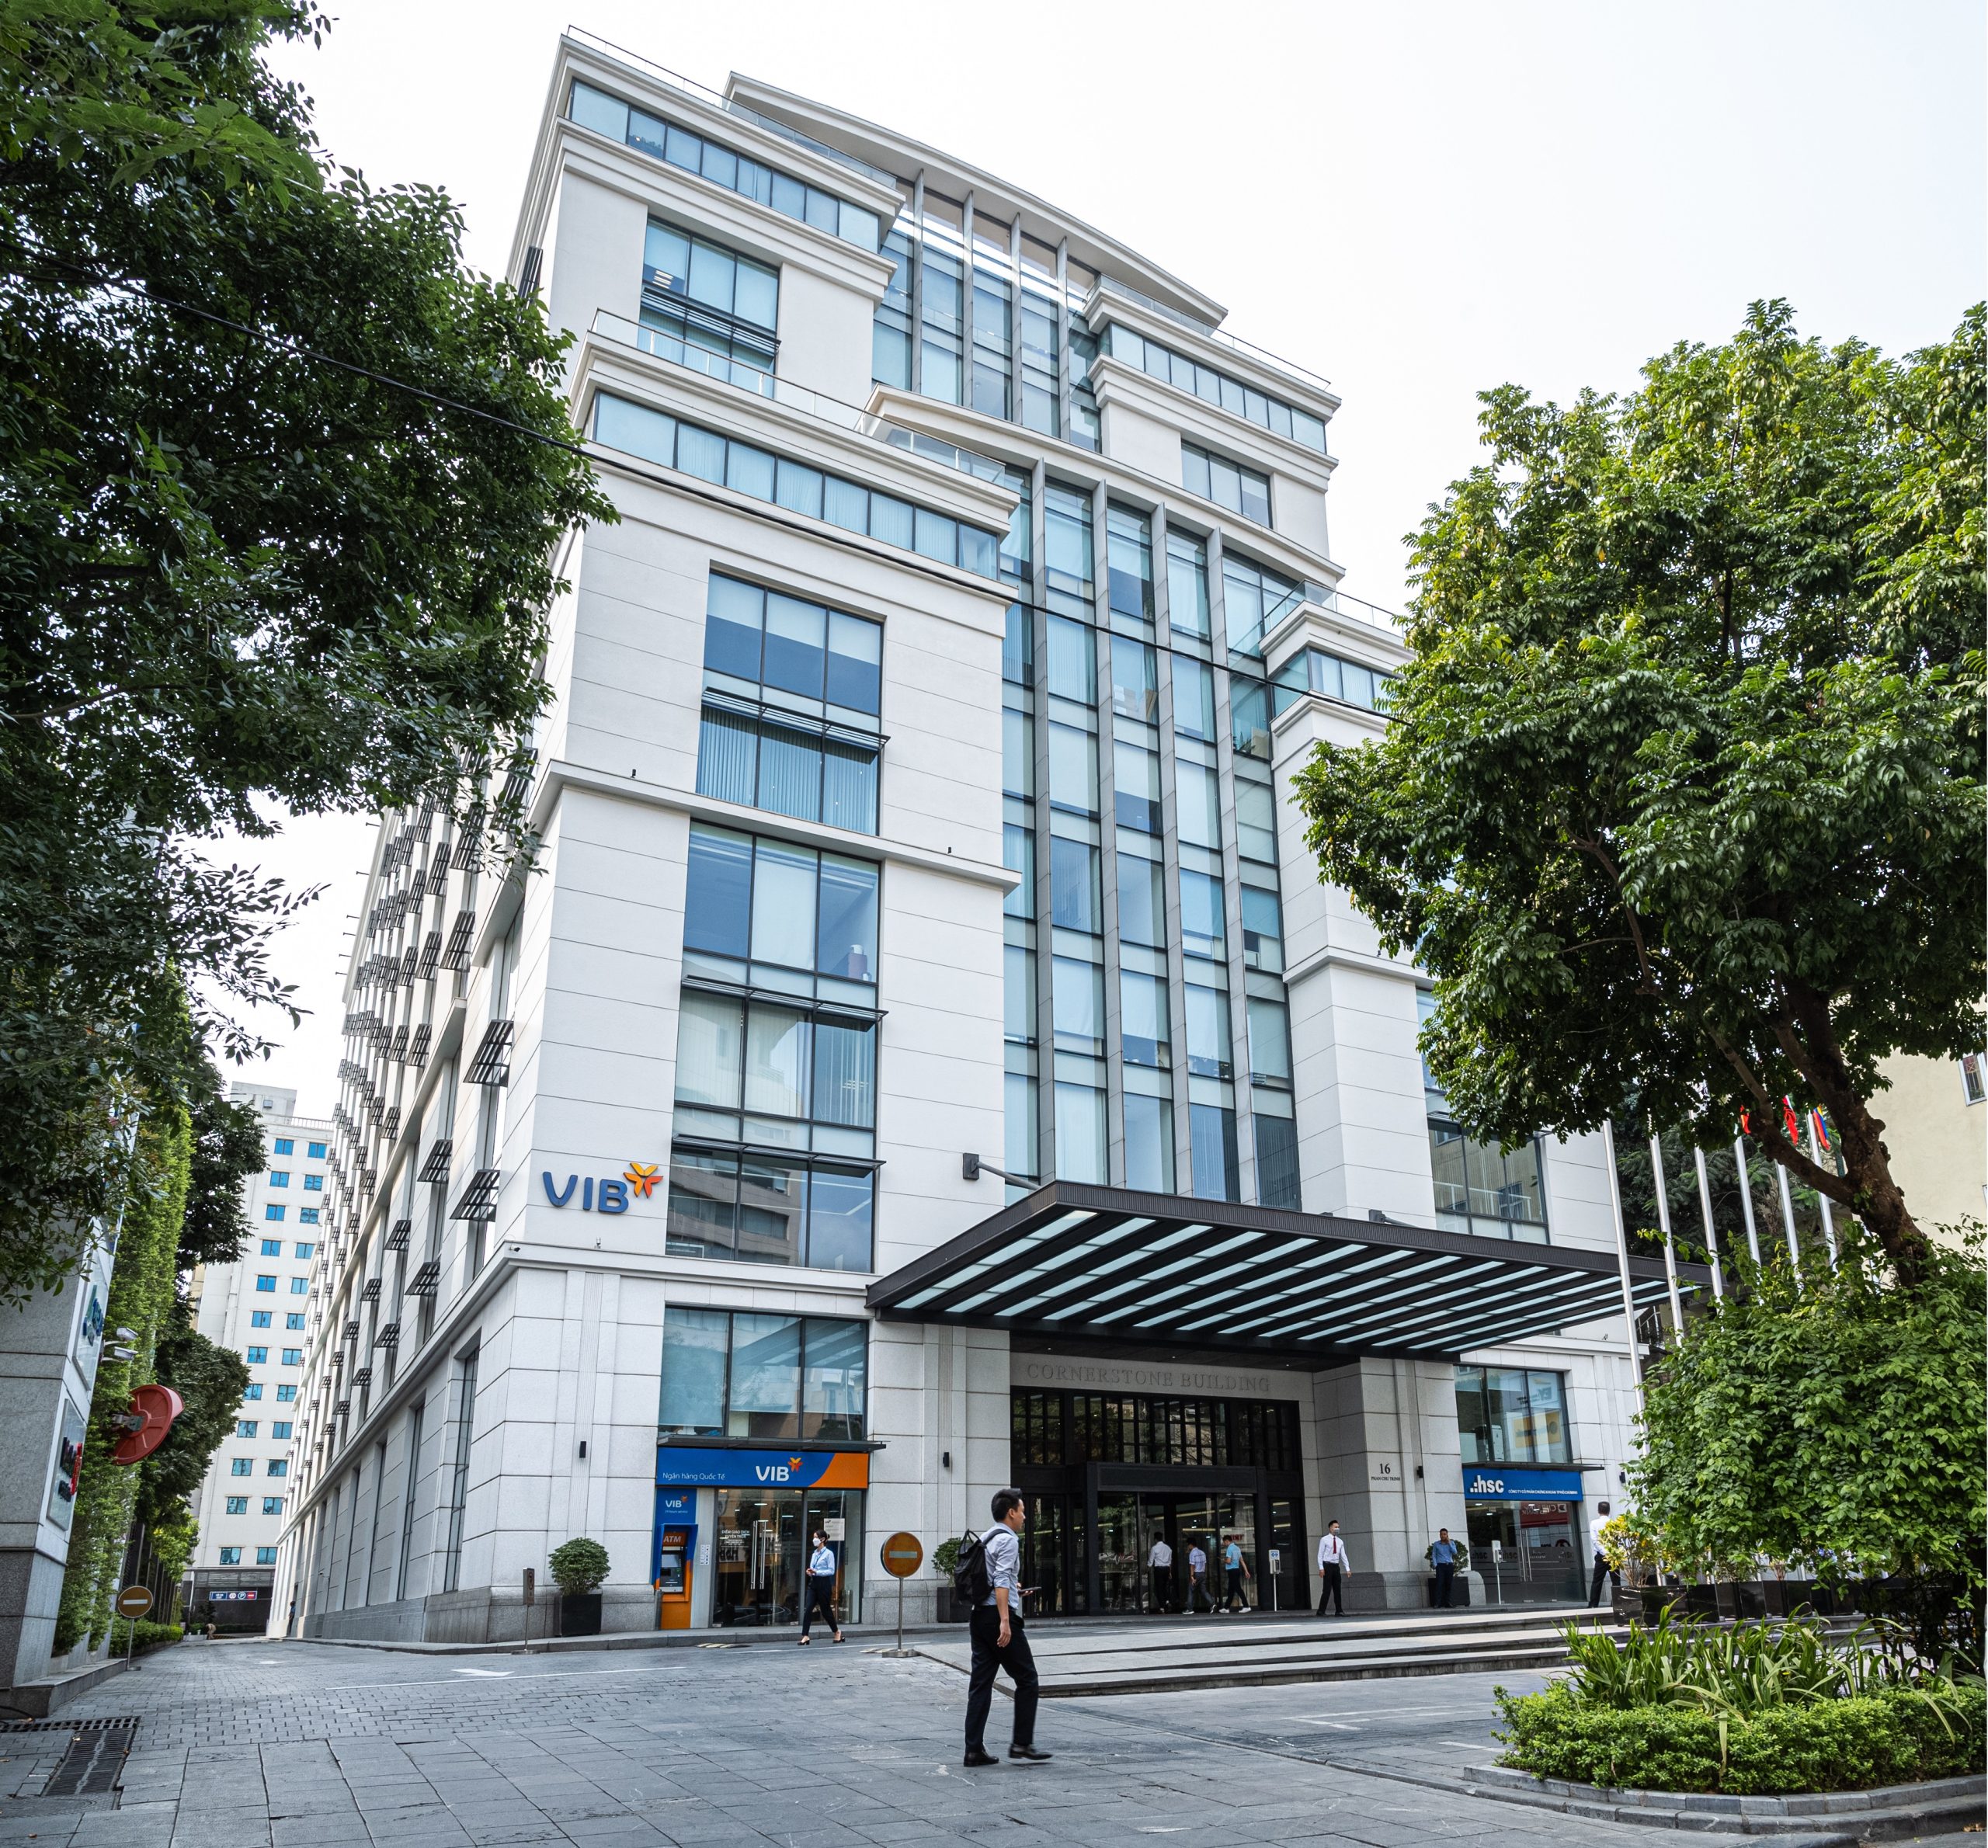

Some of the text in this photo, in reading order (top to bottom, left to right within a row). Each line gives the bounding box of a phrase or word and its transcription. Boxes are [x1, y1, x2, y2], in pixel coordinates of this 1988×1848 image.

[542, 1171, 629, 1213] VIB
[1027, 1363, 1271, 1392] CORNERSTONE BUILDING
[755, 1465, 790, 1482] VIB
[1379, 1463, 1391, 1475] 16
[662, 1472, 680, 1482] Ngân
[681, 1472, 698, 1482] hàng
[699, 1472, 716, 1481] Quốc
[665, 1499, 683, 1508] VIB
